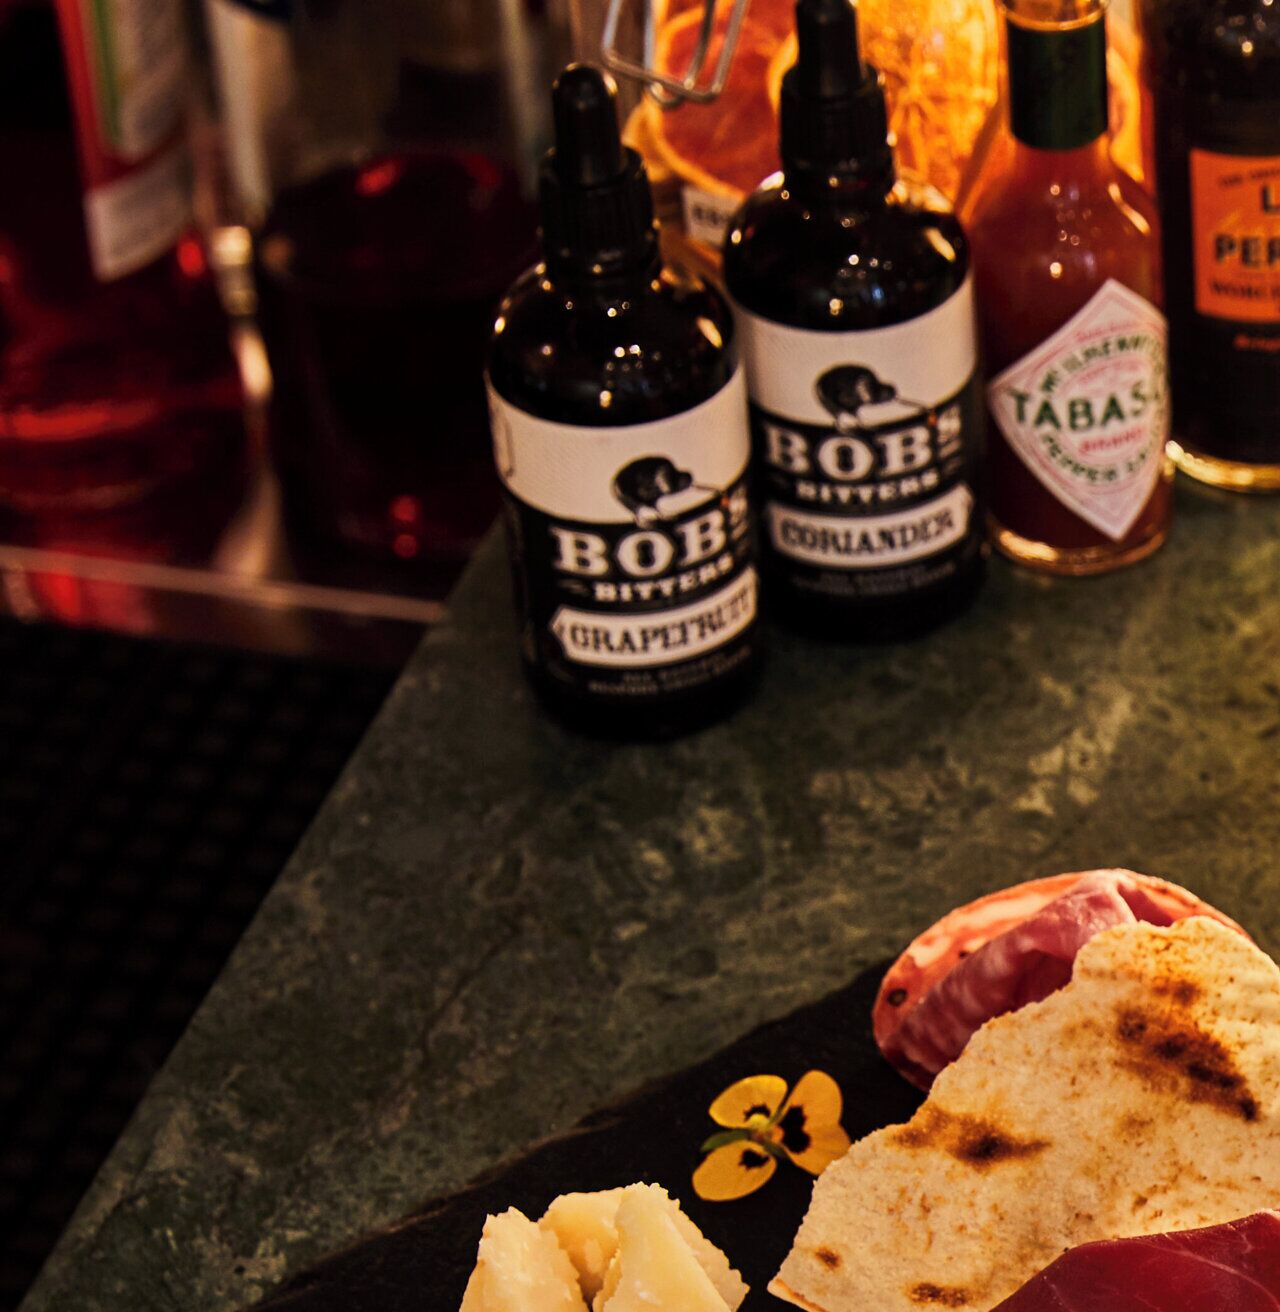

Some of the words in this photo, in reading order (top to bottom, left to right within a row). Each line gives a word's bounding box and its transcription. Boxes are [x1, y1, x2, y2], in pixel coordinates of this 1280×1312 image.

[796, 469, 939, 503] BITTERS
[781, 508, 954, 556] CORIANDER
[594, 552, 735, 602] BITTERS
[569, 584, 752, 654] GRAPEFRUIT
